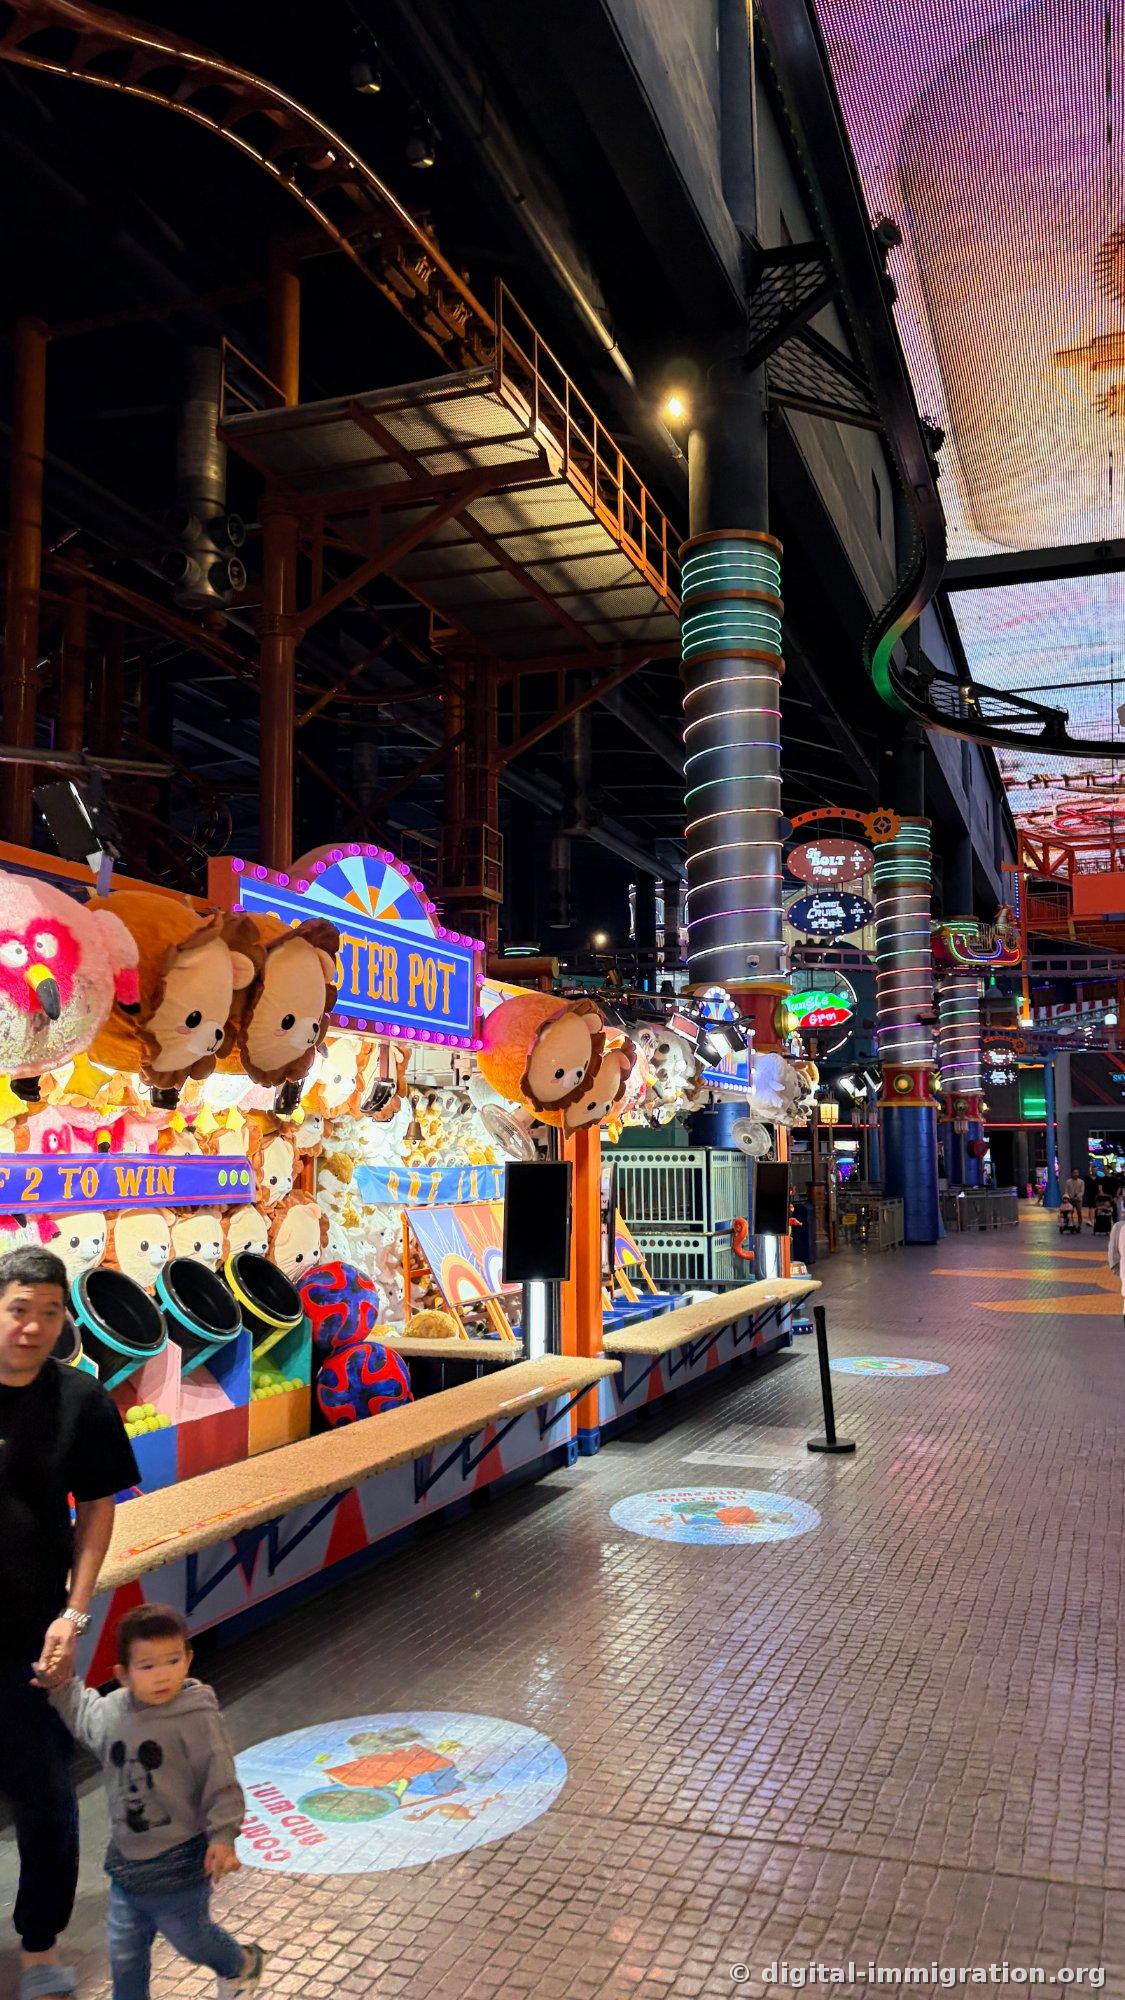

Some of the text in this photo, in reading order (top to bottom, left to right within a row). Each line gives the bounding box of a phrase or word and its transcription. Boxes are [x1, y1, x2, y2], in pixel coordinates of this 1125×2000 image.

[855, 914, 861, 922] 2
[408, 952, 456, 1015] POT
[21, 1167, 43, 1201] 2
[58, 1166, 99, 1199] TO
[114, 1166, 177, 1197] WIN
